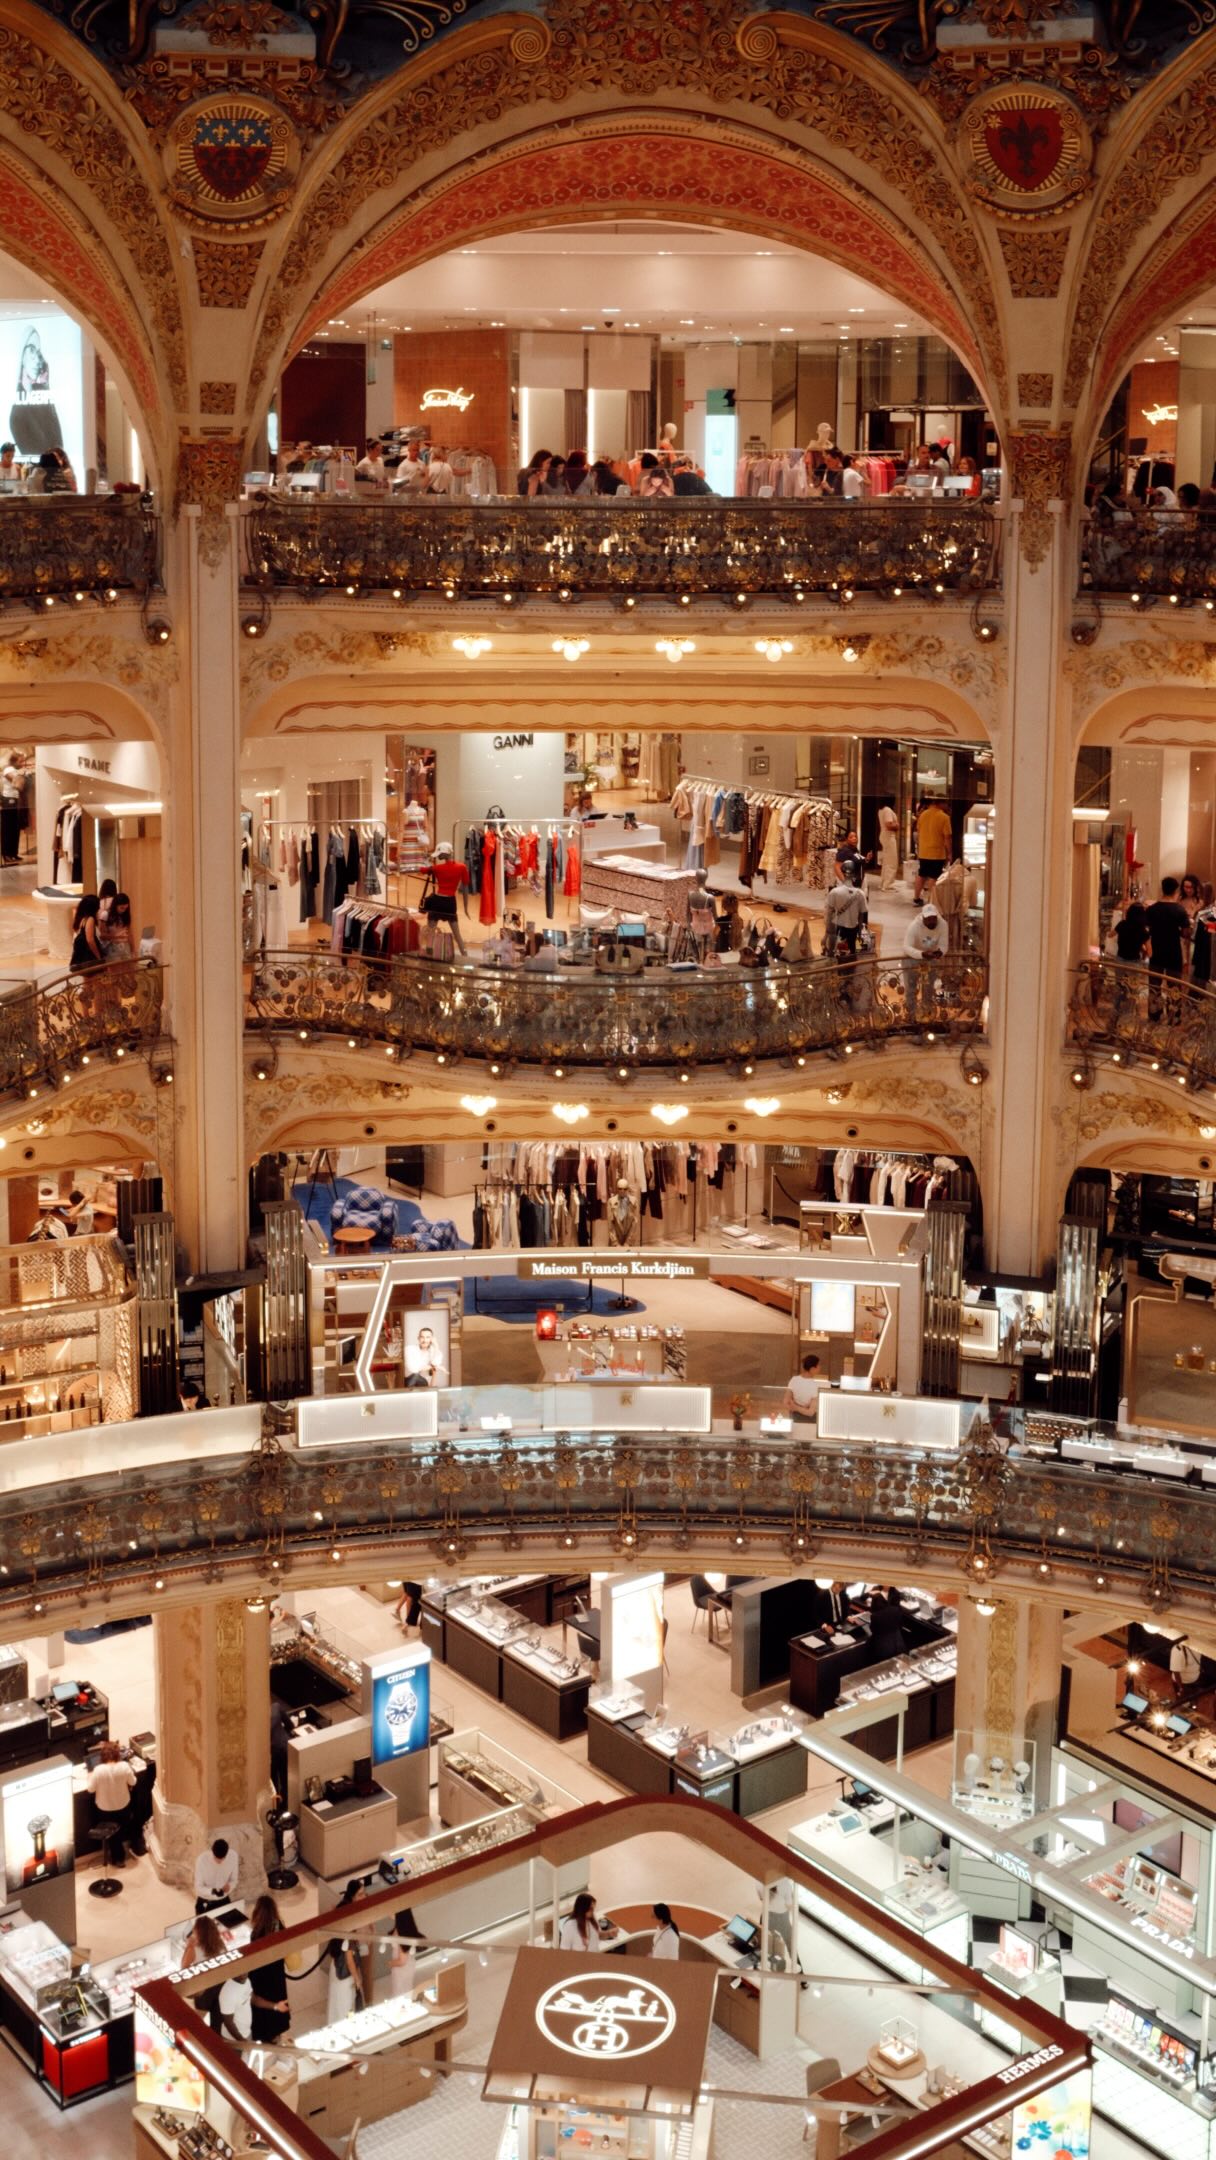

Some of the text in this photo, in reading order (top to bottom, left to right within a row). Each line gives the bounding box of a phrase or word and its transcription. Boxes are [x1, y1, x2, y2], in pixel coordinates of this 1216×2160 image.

[493, 733, 534, 750] GANNI
[78, 756, 111, 775] FRAME
[532, 1261, 695, 1278] Maison Francis Kurkdjian
[386, 1668, 416, 1685] CITIZEN
[1130, 1917, 1194, 1960] PRADA
